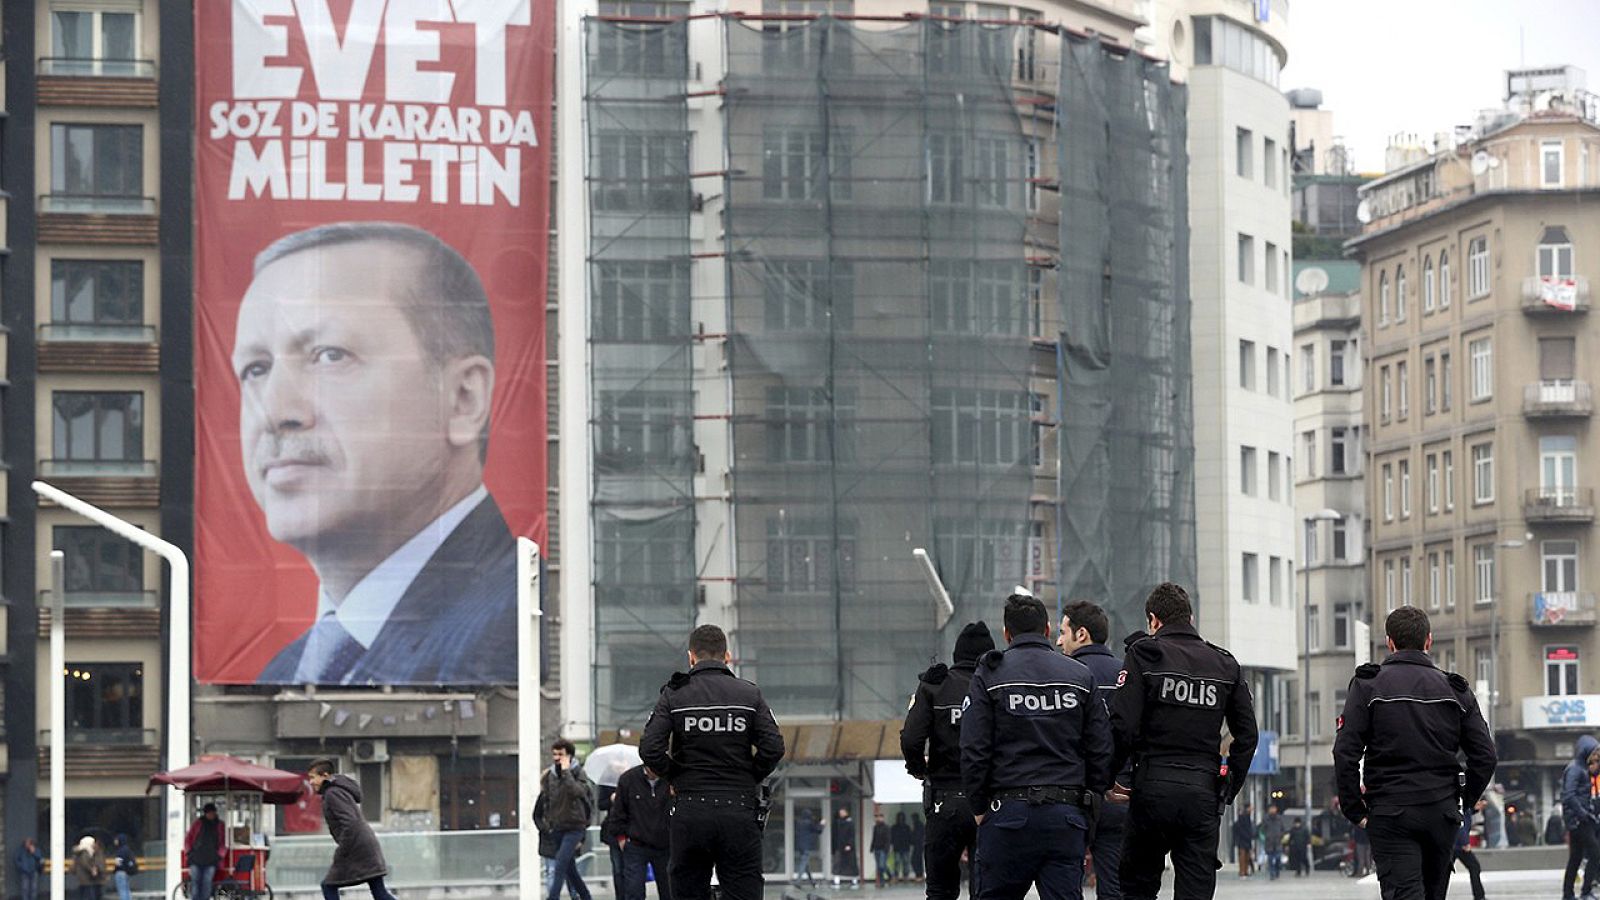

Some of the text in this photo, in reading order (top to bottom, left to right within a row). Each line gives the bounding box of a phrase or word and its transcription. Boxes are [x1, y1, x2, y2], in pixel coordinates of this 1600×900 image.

[231, 0, 531, 106] EVET
[291, 102, 340, 138] DE
[349, 103, 483, 145] KARAR
[489, 109, 539, 146] DA
[1009, 689, 1078, 711] POLİS
[1161, 677, 1217, 706] POLİS
[684, 713, 747, 732] POLİS
